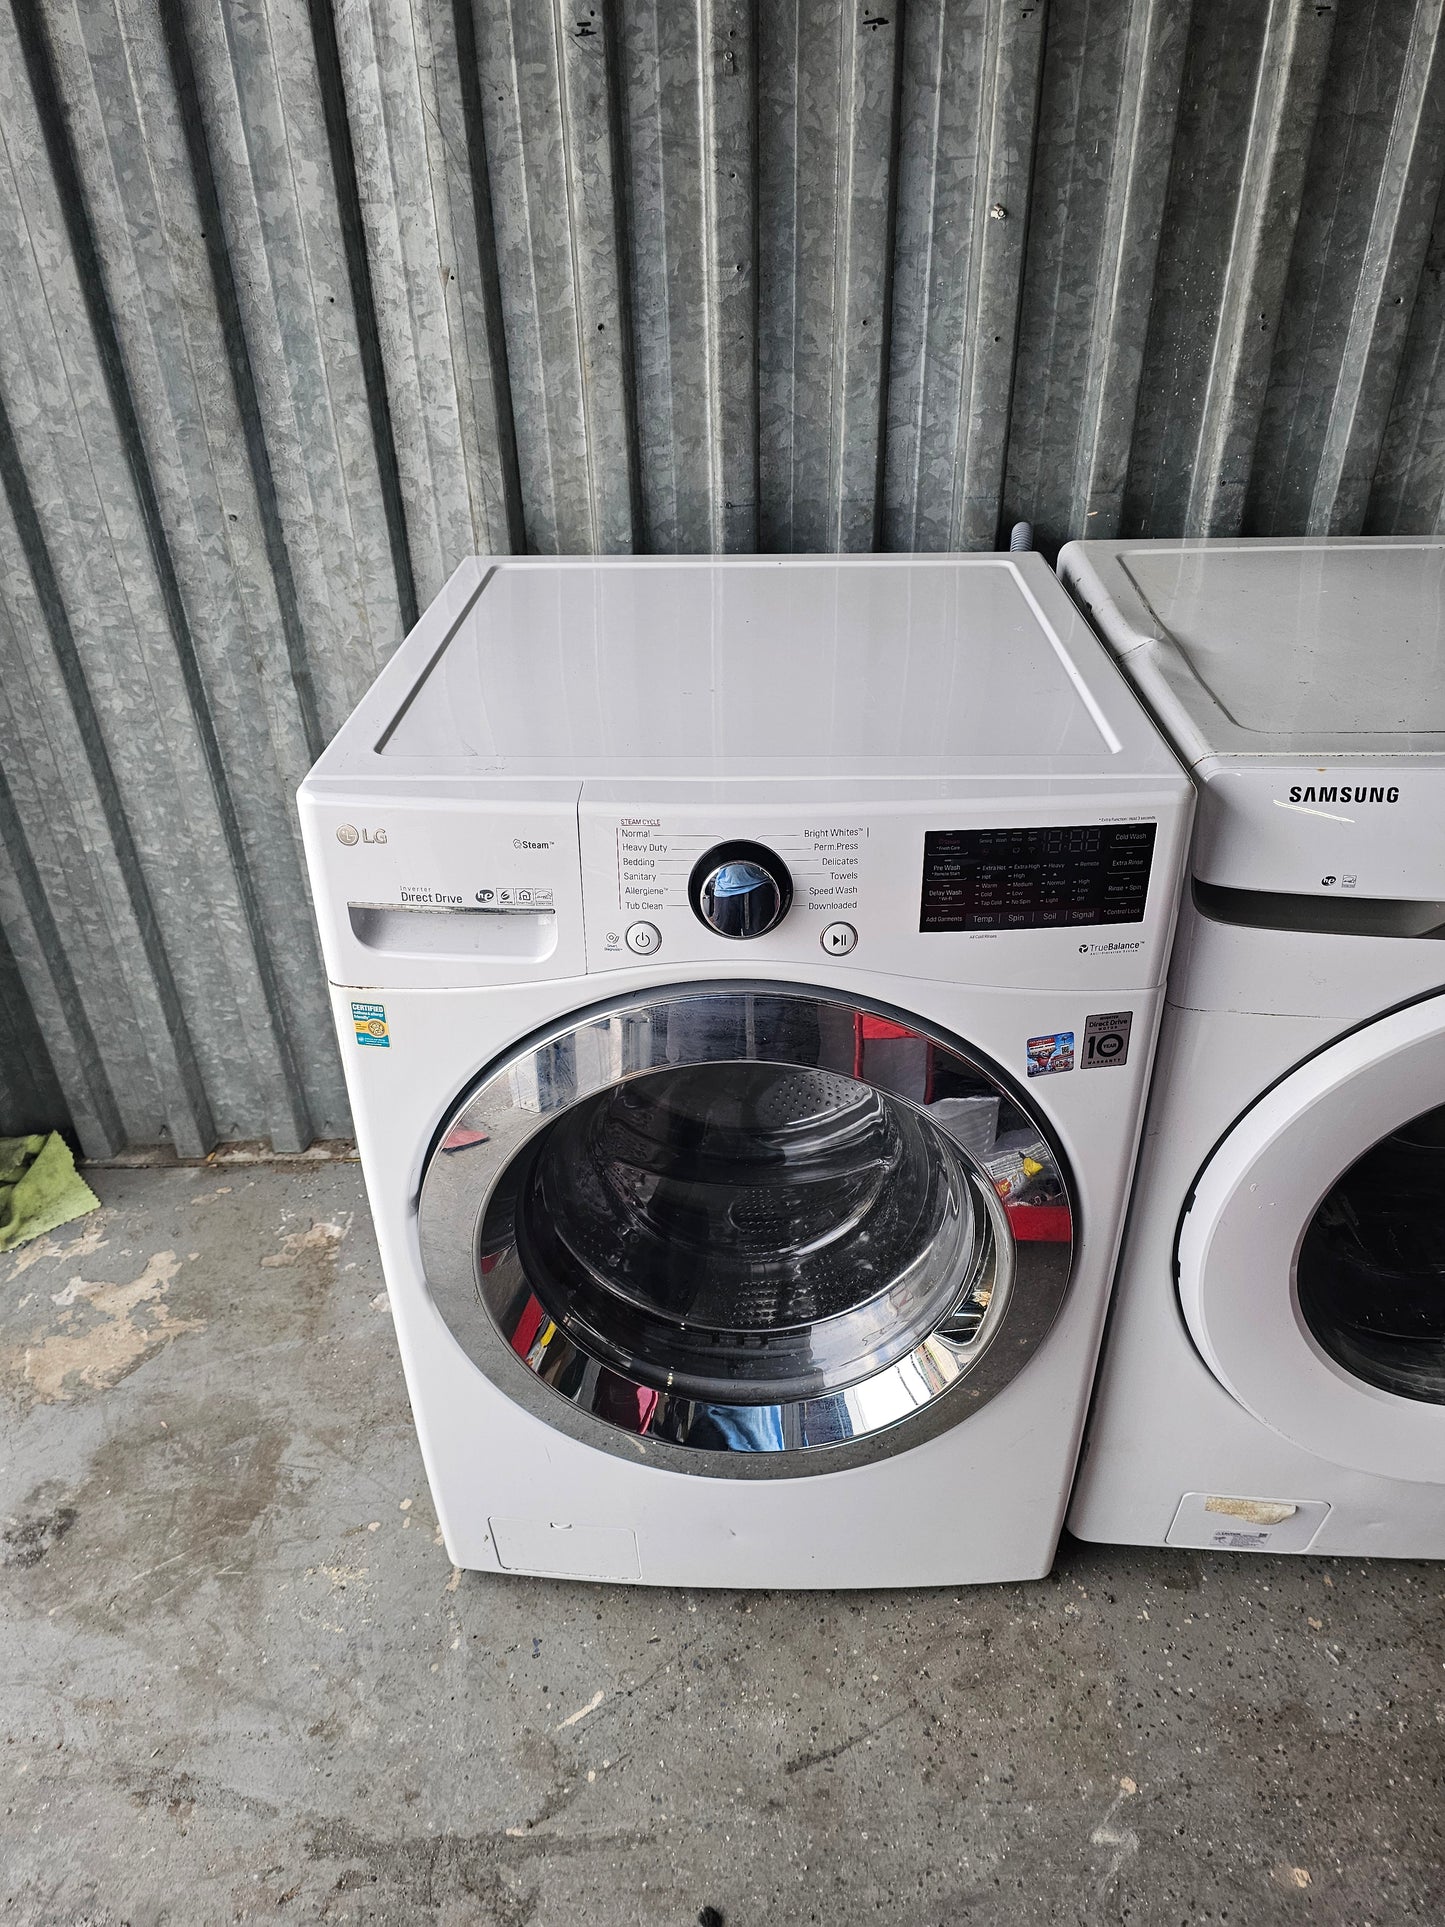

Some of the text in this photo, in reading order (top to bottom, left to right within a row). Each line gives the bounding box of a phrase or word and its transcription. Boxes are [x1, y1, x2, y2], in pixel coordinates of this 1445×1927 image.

[1289, 787, 1399, 803] SAMSUNG
[363, 828, 387, 844] LG
[804, 829, 828, 838] Bright
[623, 844, 667, 853] Heavy Duty
[623, 858, 655, 867] Bedding
[624, 872, 656, 882] Sanitary
[830, 872, 858, 880] Towels
[809, 886, 858, 896] Speed Wash
[401, 892, 463, 904] Direct Drive
[642, 902, 663, 910] Clean
[809, 902, 857, 910] Downloaded
[973, 915, 995, 923] Temp.
[1008, 914, 1024, 922] Spin
[1072, 911, 1094, 919] Signal
[353, 1004, 383, 1012] CERTIFIED
[1088, 1034, 1123, 1058] 10
